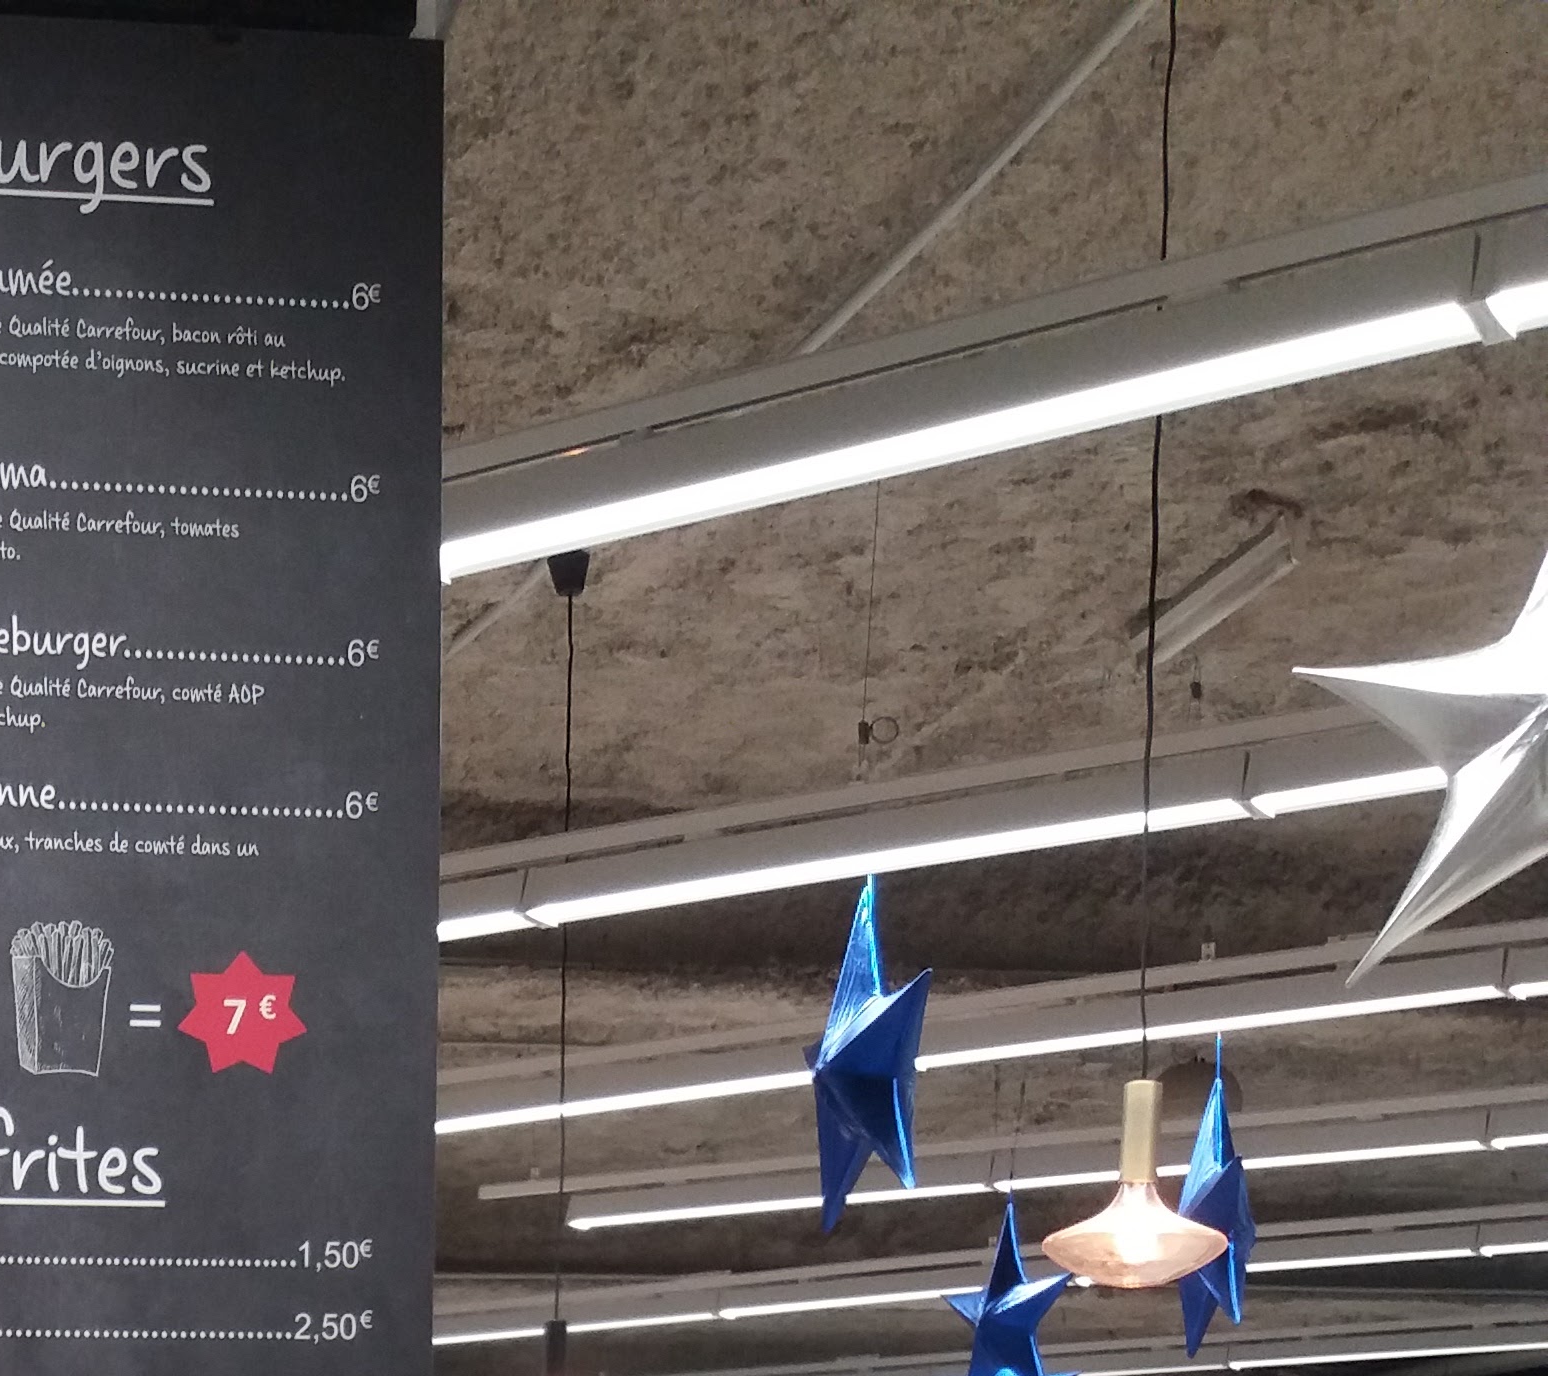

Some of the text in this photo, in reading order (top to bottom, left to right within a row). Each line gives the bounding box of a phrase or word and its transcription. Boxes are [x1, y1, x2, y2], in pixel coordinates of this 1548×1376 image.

[349, 283, 381, 310] 6€
[9, 315, 69, 337] Qualité
[77, 317, 165, 345] Carrefour,
[173, 322, 221, 343] bacon
[228, 326, 257, 345] rôti
[265, 334, 285, 347] au
[0, 350, 78, 373] compotée
[86, 349, 169, 378] d'oignons,
[177, 360, 239, 376] sucrine
[247, 359, 264, 377] et
[271, 360, 345, 387] ketchup.
[347, 475, 380, 502] 6€
[10, 509, 69, 531] Qualité
[77, 510, 164, 538] Carrefour,
[171, 517, 239, 538] tomates
[345, 639, 379, 667] 6€
[11, 675, 70, 698] Qualité
[78, 676, 165, 704] Carrefour,
[173, 684, 221, 702] comté
[229, 683, 264, 705] AOP
[343, 791, 378, 819] 6€
[25, 830, 103, 852] tranches
[110, 831, 128, 853] de
[135, 835, 184, 855] comté
[191, 834, 230, 855] dans
[237, 843, 259, 856] un
